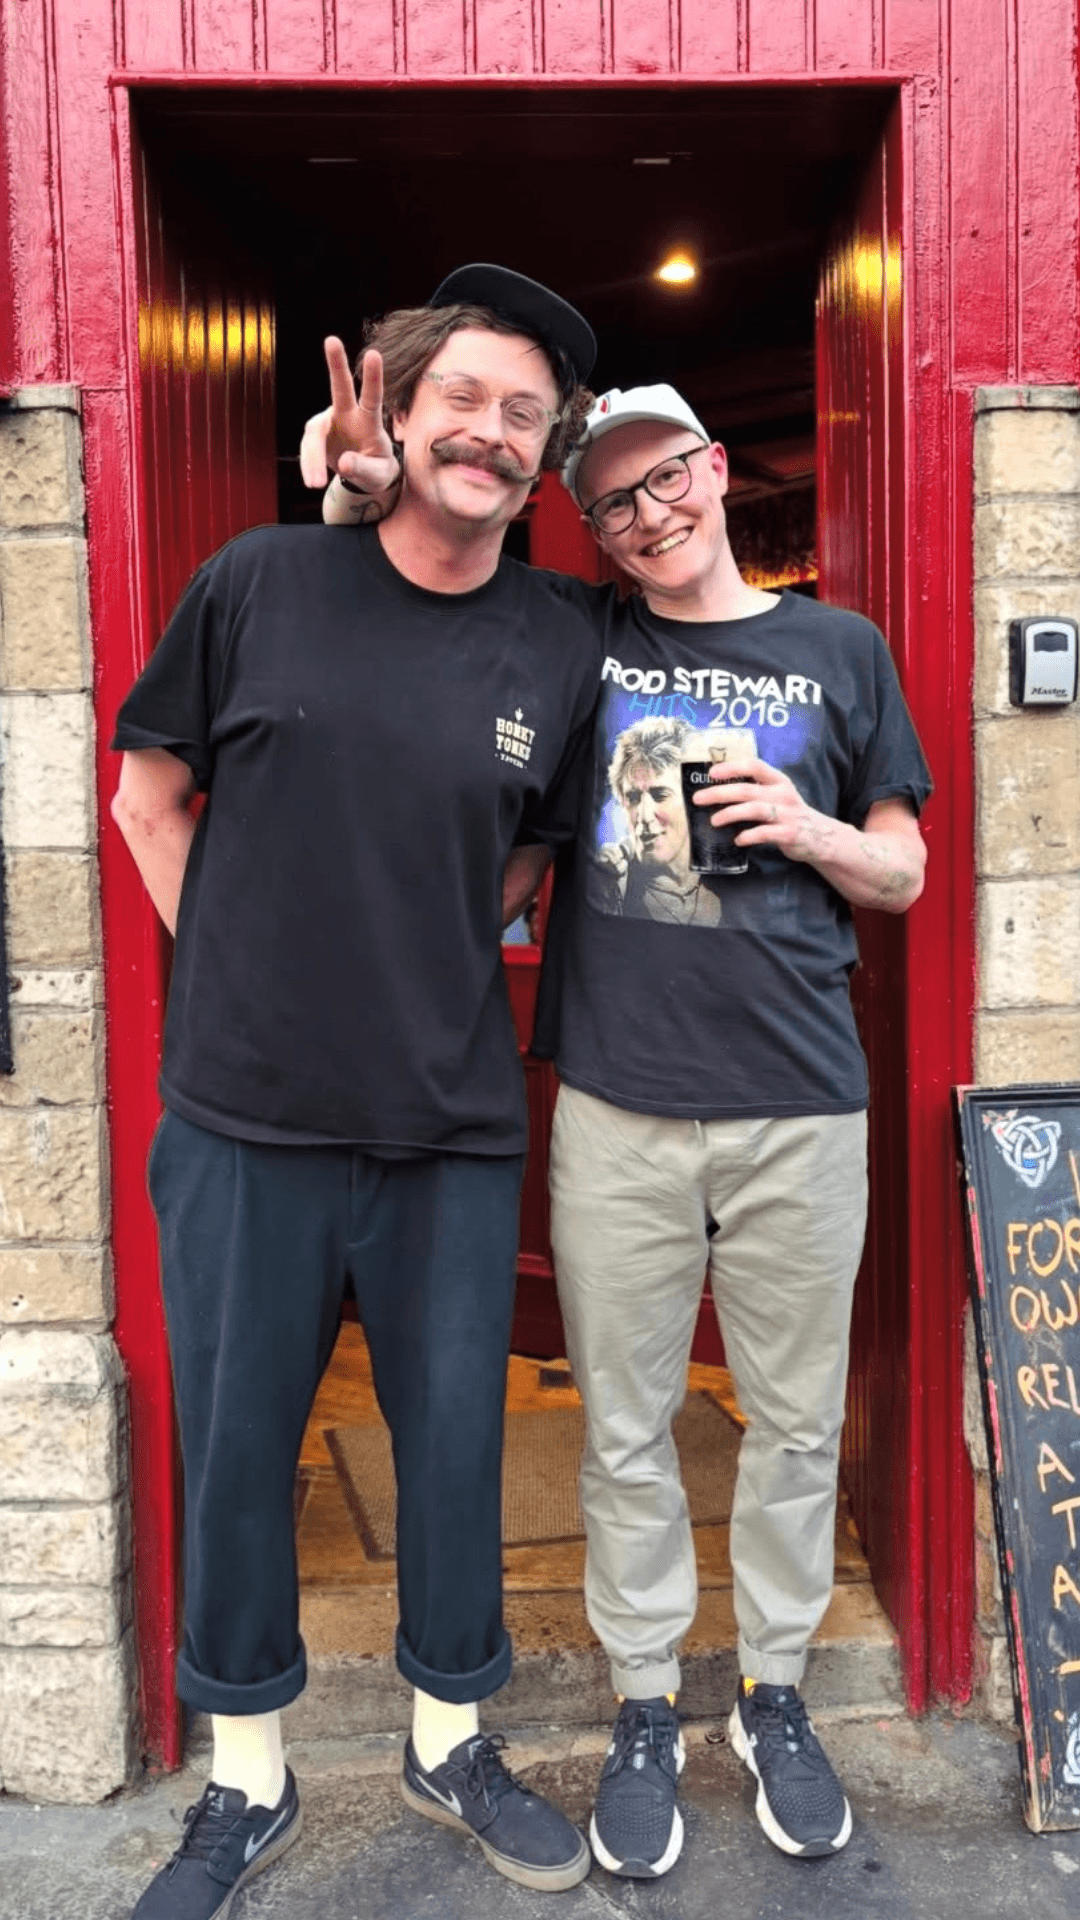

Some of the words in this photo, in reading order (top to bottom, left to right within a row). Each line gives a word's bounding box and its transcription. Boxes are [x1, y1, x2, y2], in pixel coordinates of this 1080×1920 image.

[601, 656, 666, 694] ROD
[673, 666, 822, 705] STEWART
[628, 692, 698, 724] HITS
[709, 697, 789, 727] 2016
[496, 717, 535, 745] HONKY
[1010, 1279, 1080, 1332] OW
